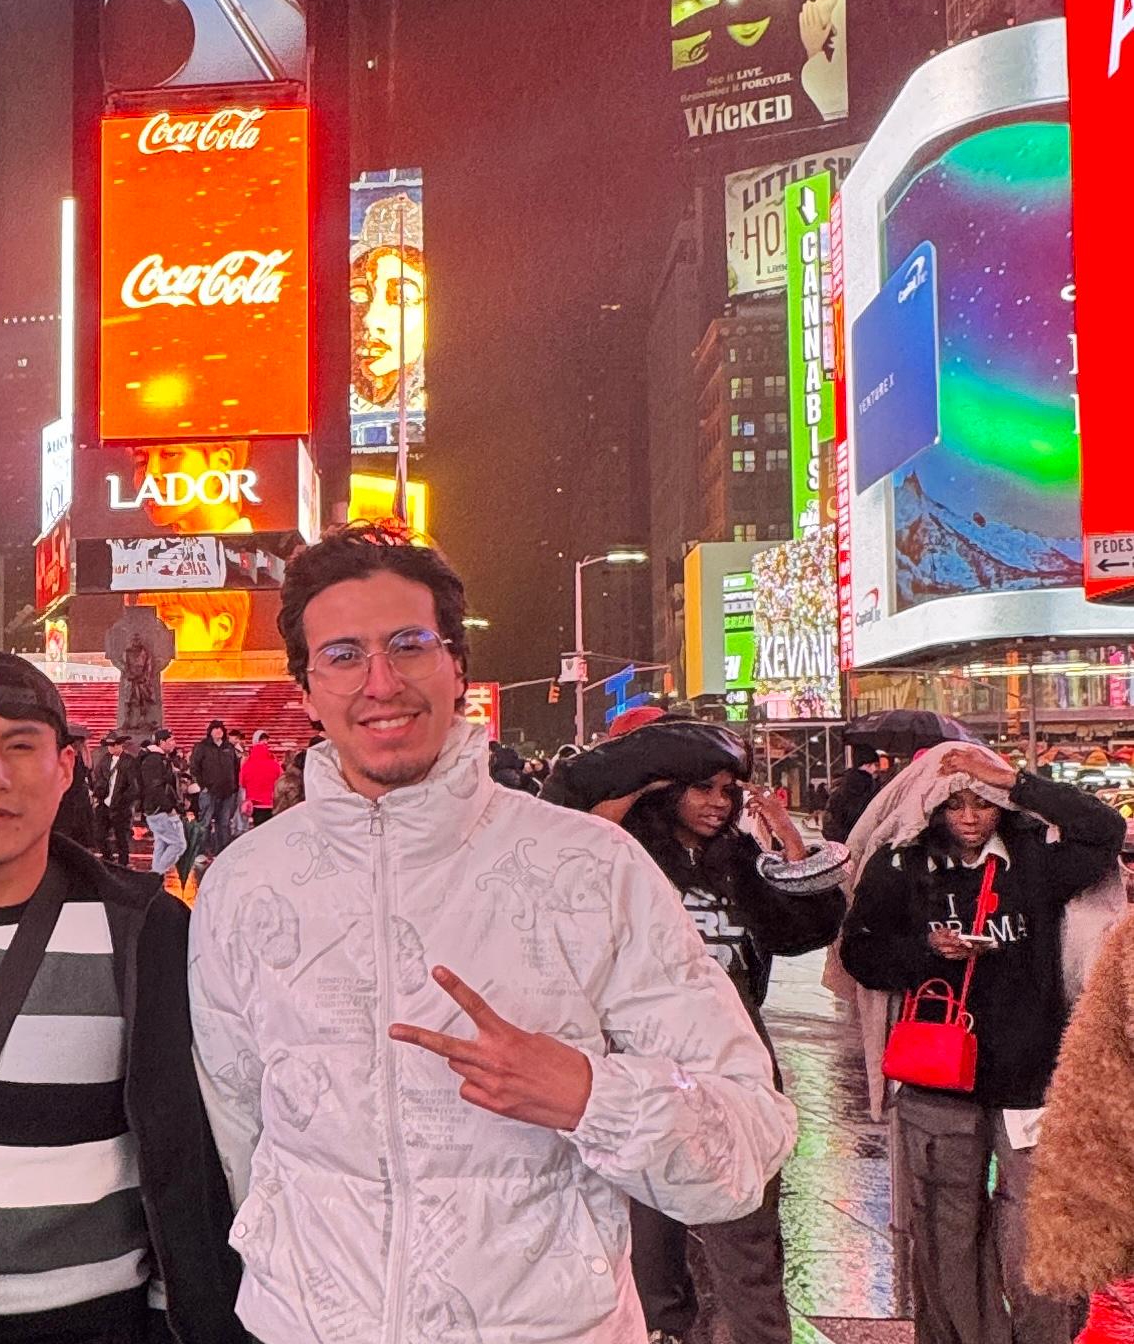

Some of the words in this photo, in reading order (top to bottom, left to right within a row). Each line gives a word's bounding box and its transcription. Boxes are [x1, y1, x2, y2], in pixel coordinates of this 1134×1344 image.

[137, 107, 266, 155] Coca-Cola
[742, 159, 817, 212] LITTLE
[823, 157, 859, 180] SH
[121, 249, 294, 309] Coca-Cola
[801, 230, 822, 491] CANNABIS
[105, 468, 263, 511] LADOR
